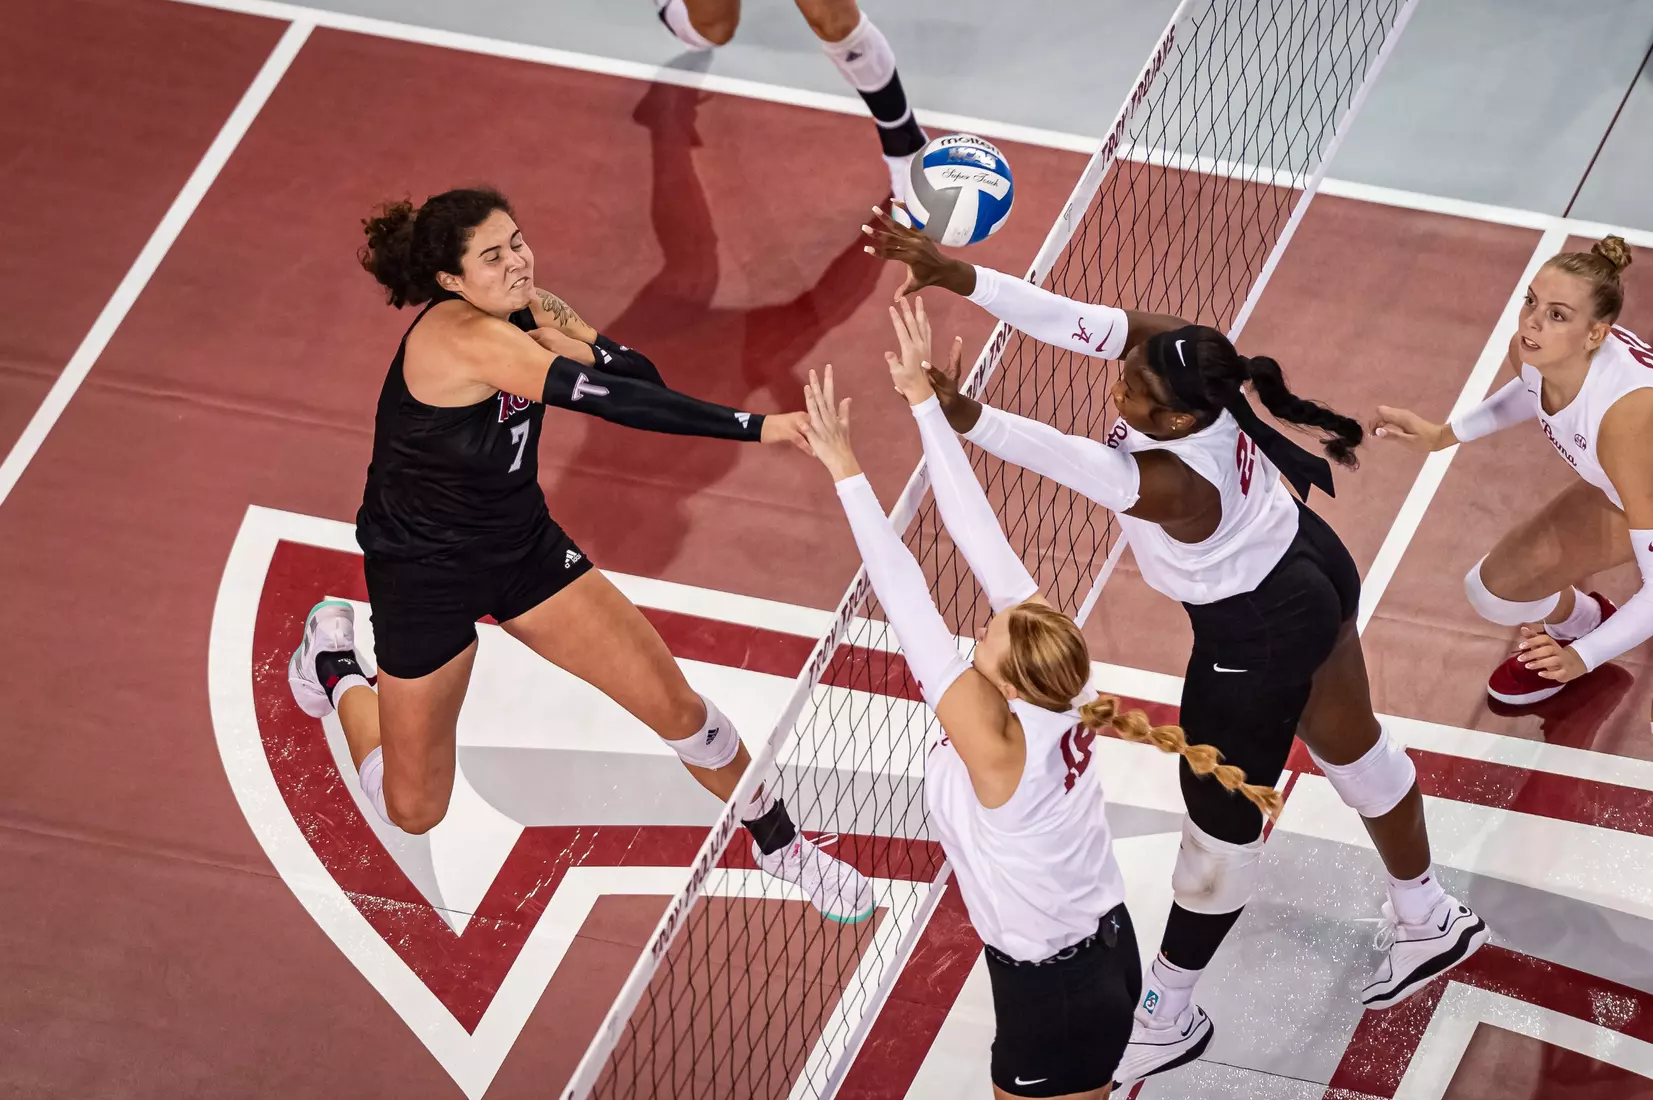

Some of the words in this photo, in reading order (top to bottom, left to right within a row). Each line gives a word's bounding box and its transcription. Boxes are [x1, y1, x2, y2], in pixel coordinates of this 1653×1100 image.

[1101, 107, 1129, 171] TROY
[1131, 24, 1177, 119] TROJANS
[942, 168, 970, 182] Super
[973, 172, 1000, 188] Touch
[508, 418, 531, 474] 7
[1541, 418, 1577, 467] Bama
[809, 620, 838, 689] TROY
